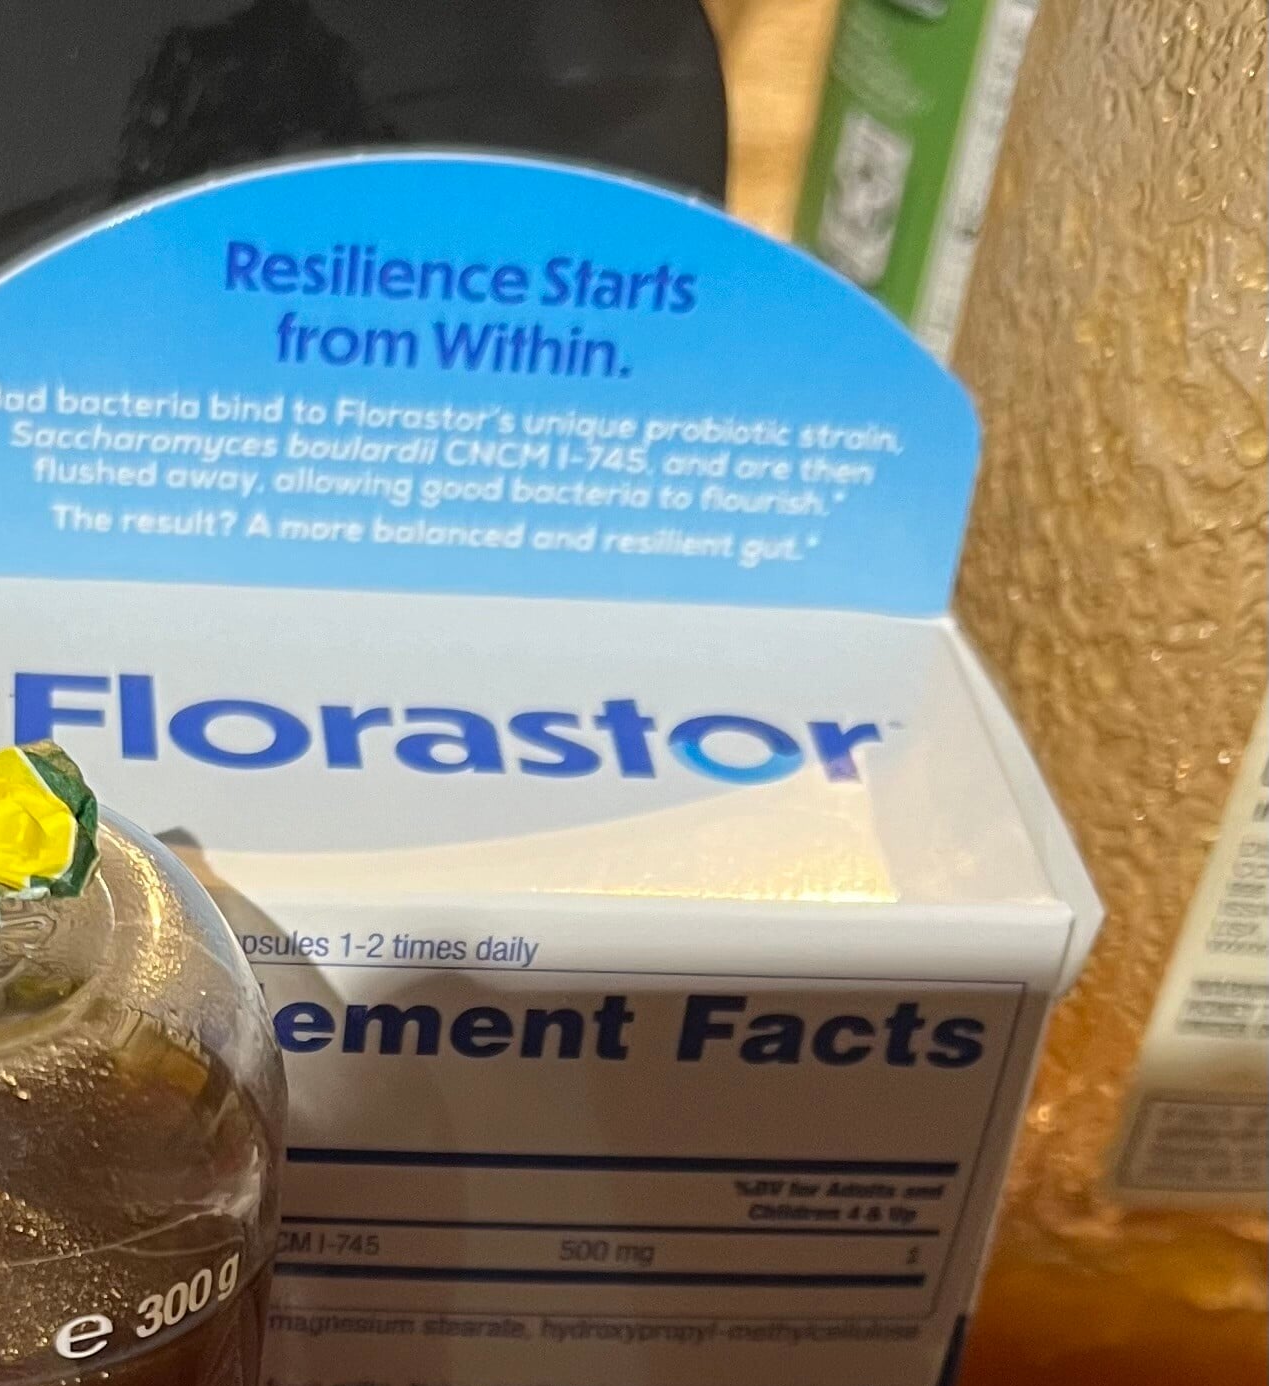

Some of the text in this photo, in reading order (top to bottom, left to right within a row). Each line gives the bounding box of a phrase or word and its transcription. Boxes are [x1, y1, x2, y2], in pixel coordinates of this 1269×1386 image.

[225, 239, 697, 314] Resilience Starts
[276, 312, 634, 378] from Within.
[57, 386, 200, 422] bacteria
[207, 392, 283, 425] bind
[293, 399, 327, 427] to
[334, 398, 514, 435] Florastor's
[523, 409, 636, 444] unique
[641, 412, 791, 452] probiotic
[798, 421, 904, 457] strain,
[10, 420, 278, 464] Saccharomyces
[286, 434, 441, 467] boulardii
[444, 439, 548, 471] CNCM
[663, 453, 727, 479] and
[736, 457, 790, 482] are
[799, 457, 875, 485] then
[33, 457, 157, 488] flushed
[165, 466, 264, 500] away,
[273, 468, 413, 509] allowing
[418, 478, 502, 511] good
[511, 478, 652, 511] bacteria
[659, 485, 694, 511] to
[51, 503, 111, 533] The
[120, 508, 235, 538] result?
[245, 512, 272, 538] A
[278, 516, 363, 544] more
[371, 517, 525, 550] balanced
[530, 524, 595, 553] and
[602, 527, 732, 559] resilient
[13, 670, 883, 786] Florastor
[237, 930, 540, 968] psules 1-2 times daily
[271, 994, 986, 1071] ement Facts
[319, 1231, 380, 1256] I-745
[559, 1239, 656, 1267] 500 mg
[268, 1312, 415, 1339] magnesium
